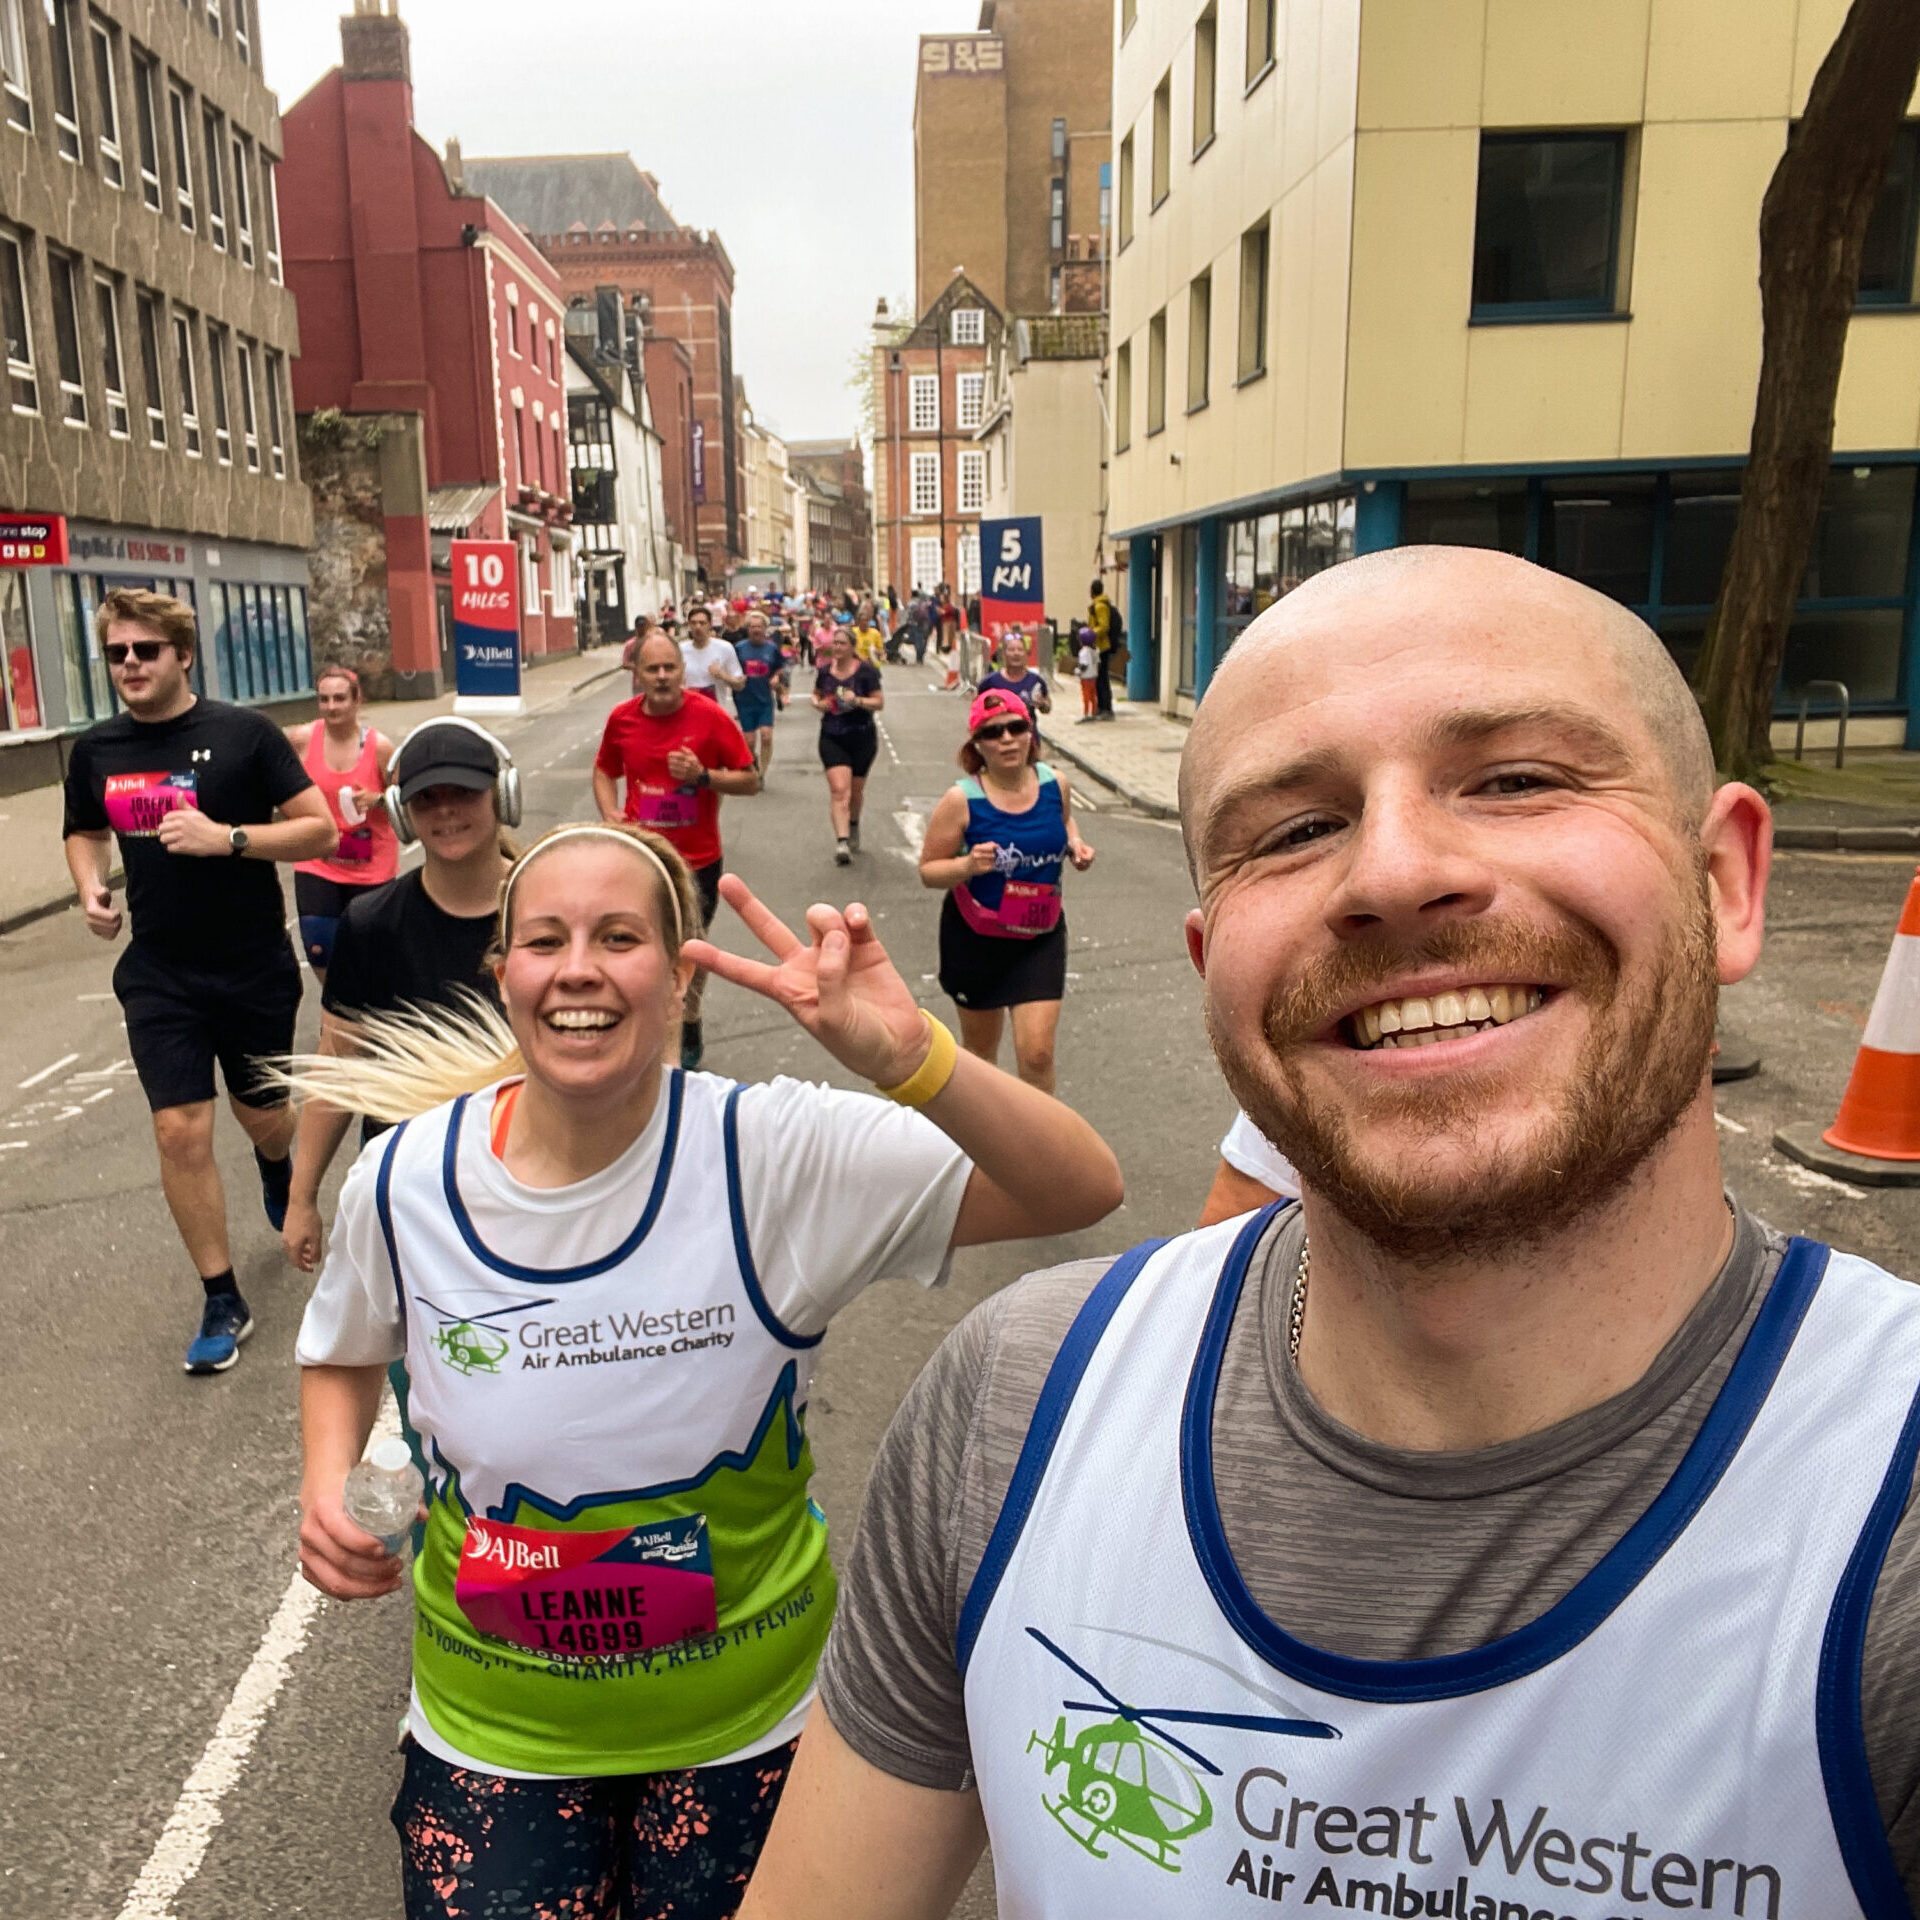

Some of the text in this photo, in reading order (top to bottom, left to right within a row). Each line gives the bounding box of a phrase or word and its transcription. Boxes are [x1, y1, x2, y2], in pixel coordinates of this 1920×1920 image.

[20, 525, 47, 540] stop
[1000, 528, 1022, 562] 5
[464, 554, 504, 587] 10
[992, 563, 1032, 593] KM
[461, 591, 511, 609] MILES
[518, 1303, 736, 1349] Great Western
[521, 1331, 735, 1370] Air Ambulance Charity
[520, 1586, 649, 1620] LEANNE
[534, 1620, 645, 1653] 14699
[667, 1635, 727, 1667] KEEP
[733, 1623, 749, 1646] IT
[754, 1584, 815, 1639] FLYING
[508, 1640, 627, 1665] GOODMOVE
[1235, 1766, 1783, 1920] Great Western
[1226, 1848, 1578, 1920] Air Ambulan
